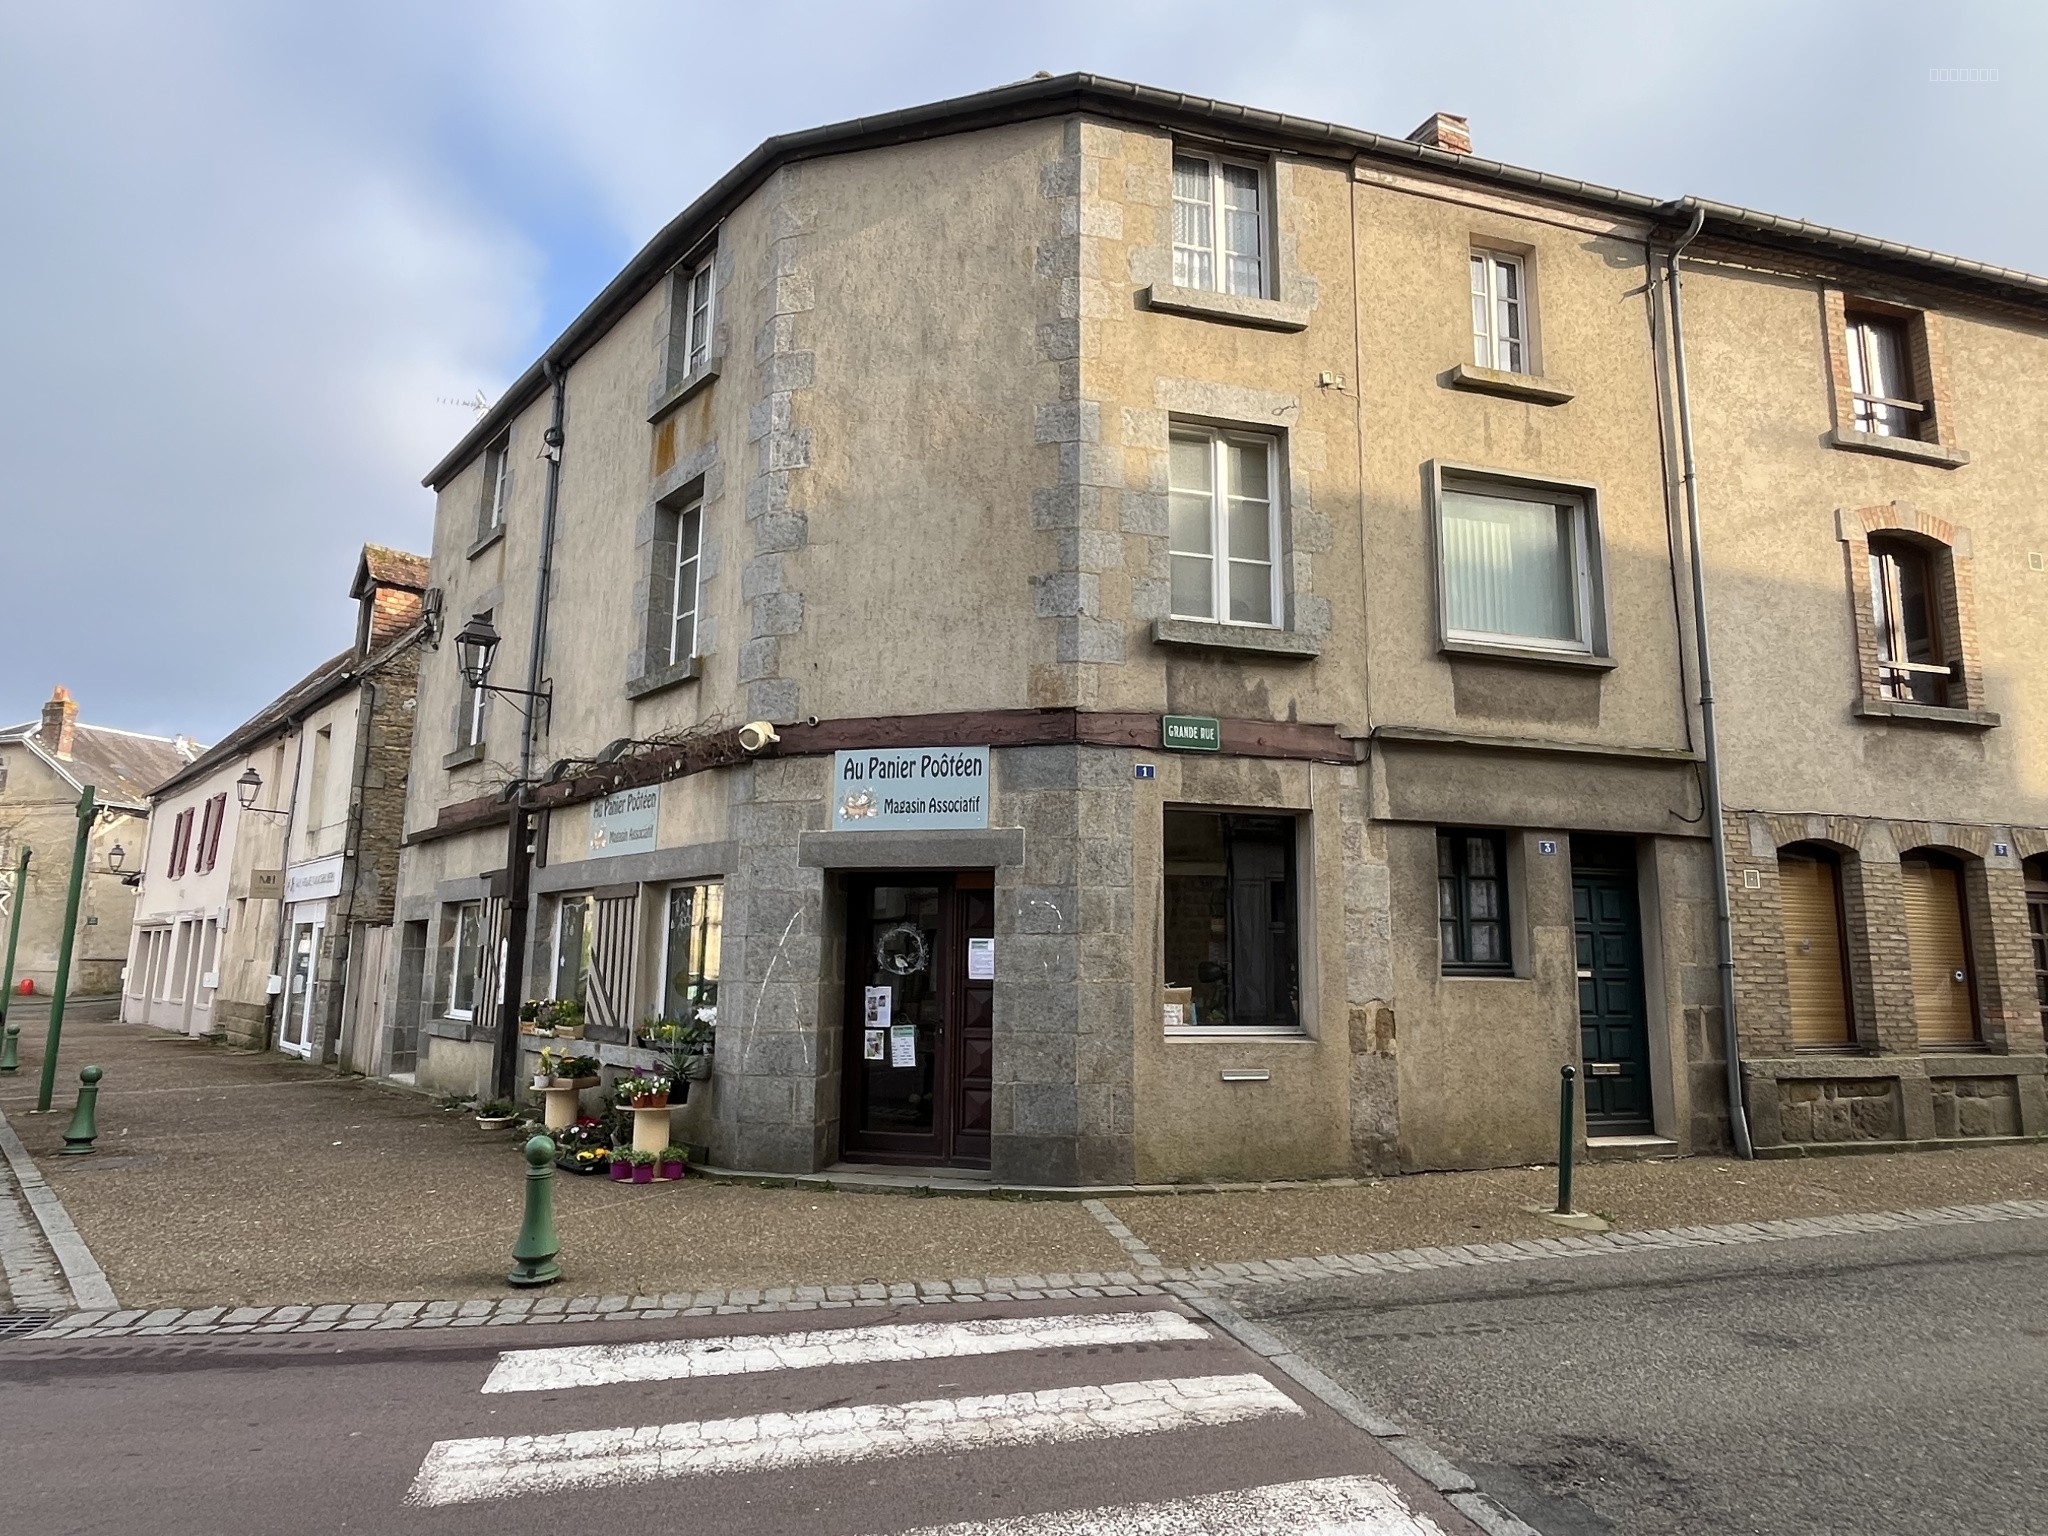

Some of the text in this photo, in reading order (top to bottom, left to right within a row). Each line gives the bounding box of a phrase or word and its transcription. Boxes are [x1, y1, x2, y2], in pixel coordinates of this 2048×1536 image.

[1168, 725, 1215, 740] GRANDE RUE
[844, 752, 982, 780] Au Panier Poôtéen
[1142, 766, 1148, 777] 1
[604, 796, 626, 817] Panier
[884, 795, 980, 815] Magasin Associatif
[1544, 843, 1552, 853] 3
